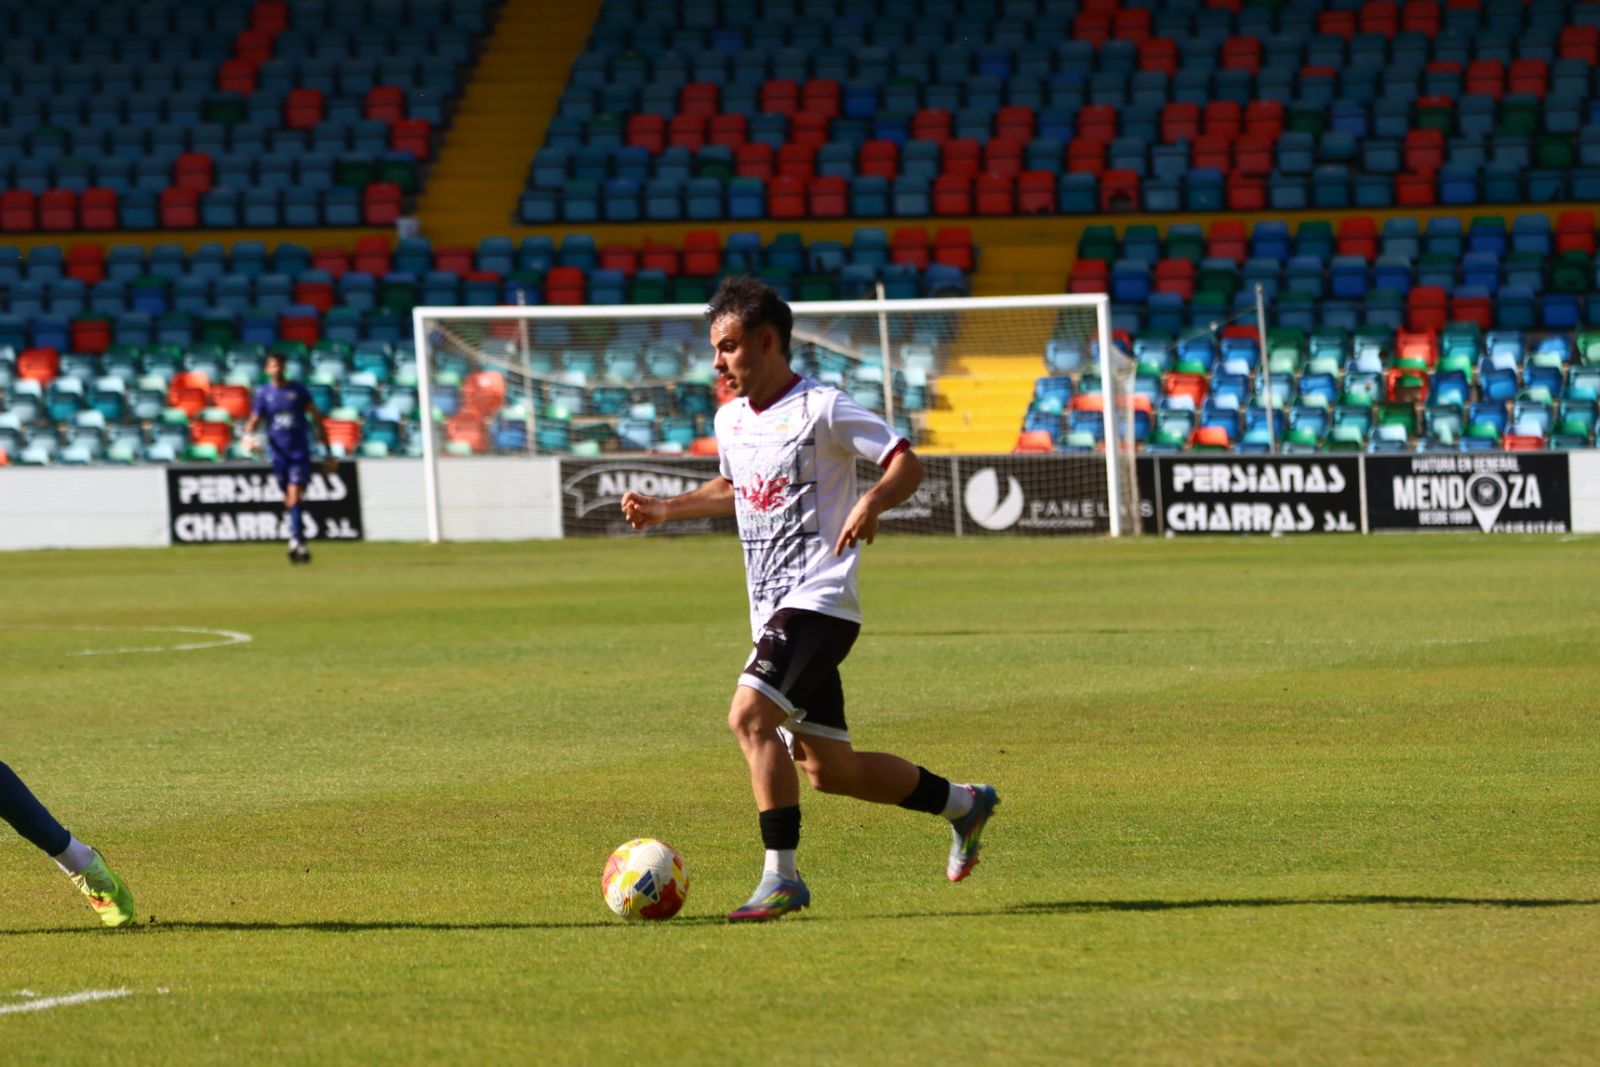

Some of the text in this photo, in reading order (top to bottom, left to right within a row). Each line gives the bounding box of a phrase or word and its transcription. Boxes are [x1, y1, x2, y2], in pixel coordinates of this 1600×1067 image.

[178, 474, 347, 504] PERSIAAS
[1392, 474, 1542, 510] MENDOZA
[1166, 503, 1315, 532] CHARRAS
